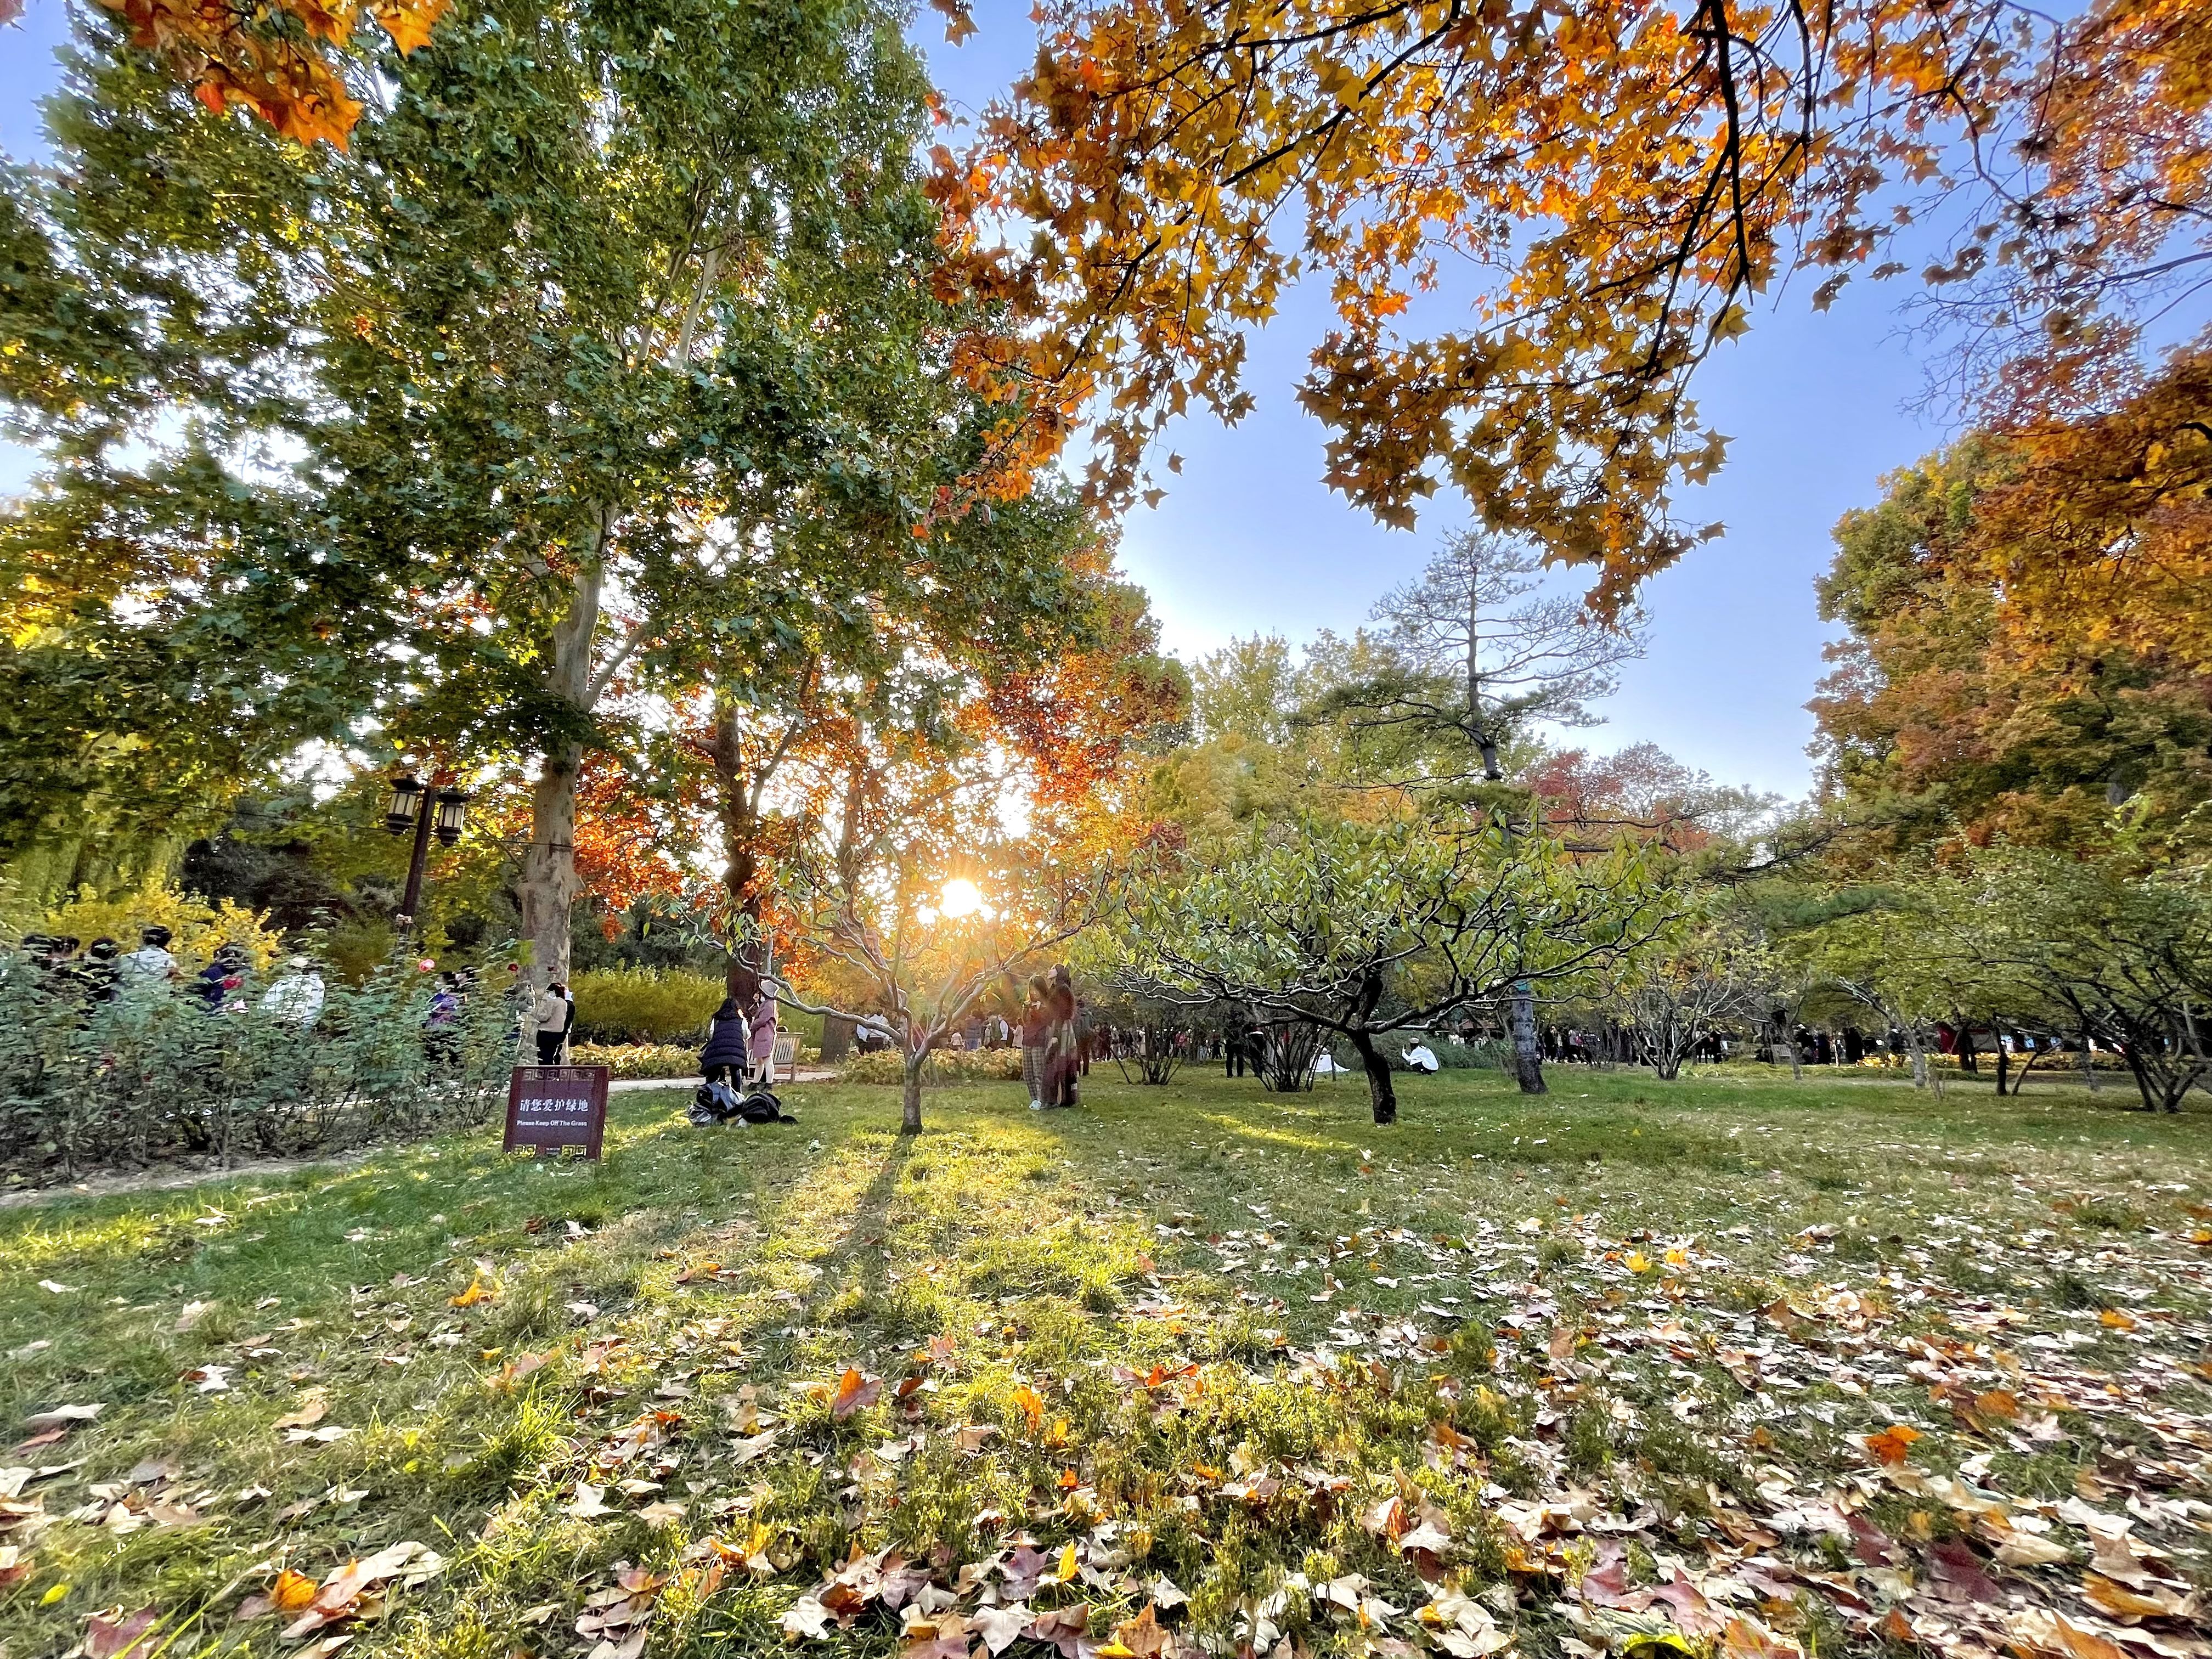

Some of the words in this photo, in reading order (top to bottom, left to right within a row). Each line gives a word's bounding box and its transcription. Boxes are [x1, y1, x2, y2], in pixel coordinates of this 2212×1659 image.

[520, 1099, 588, 1112] 请您爱护绿地
